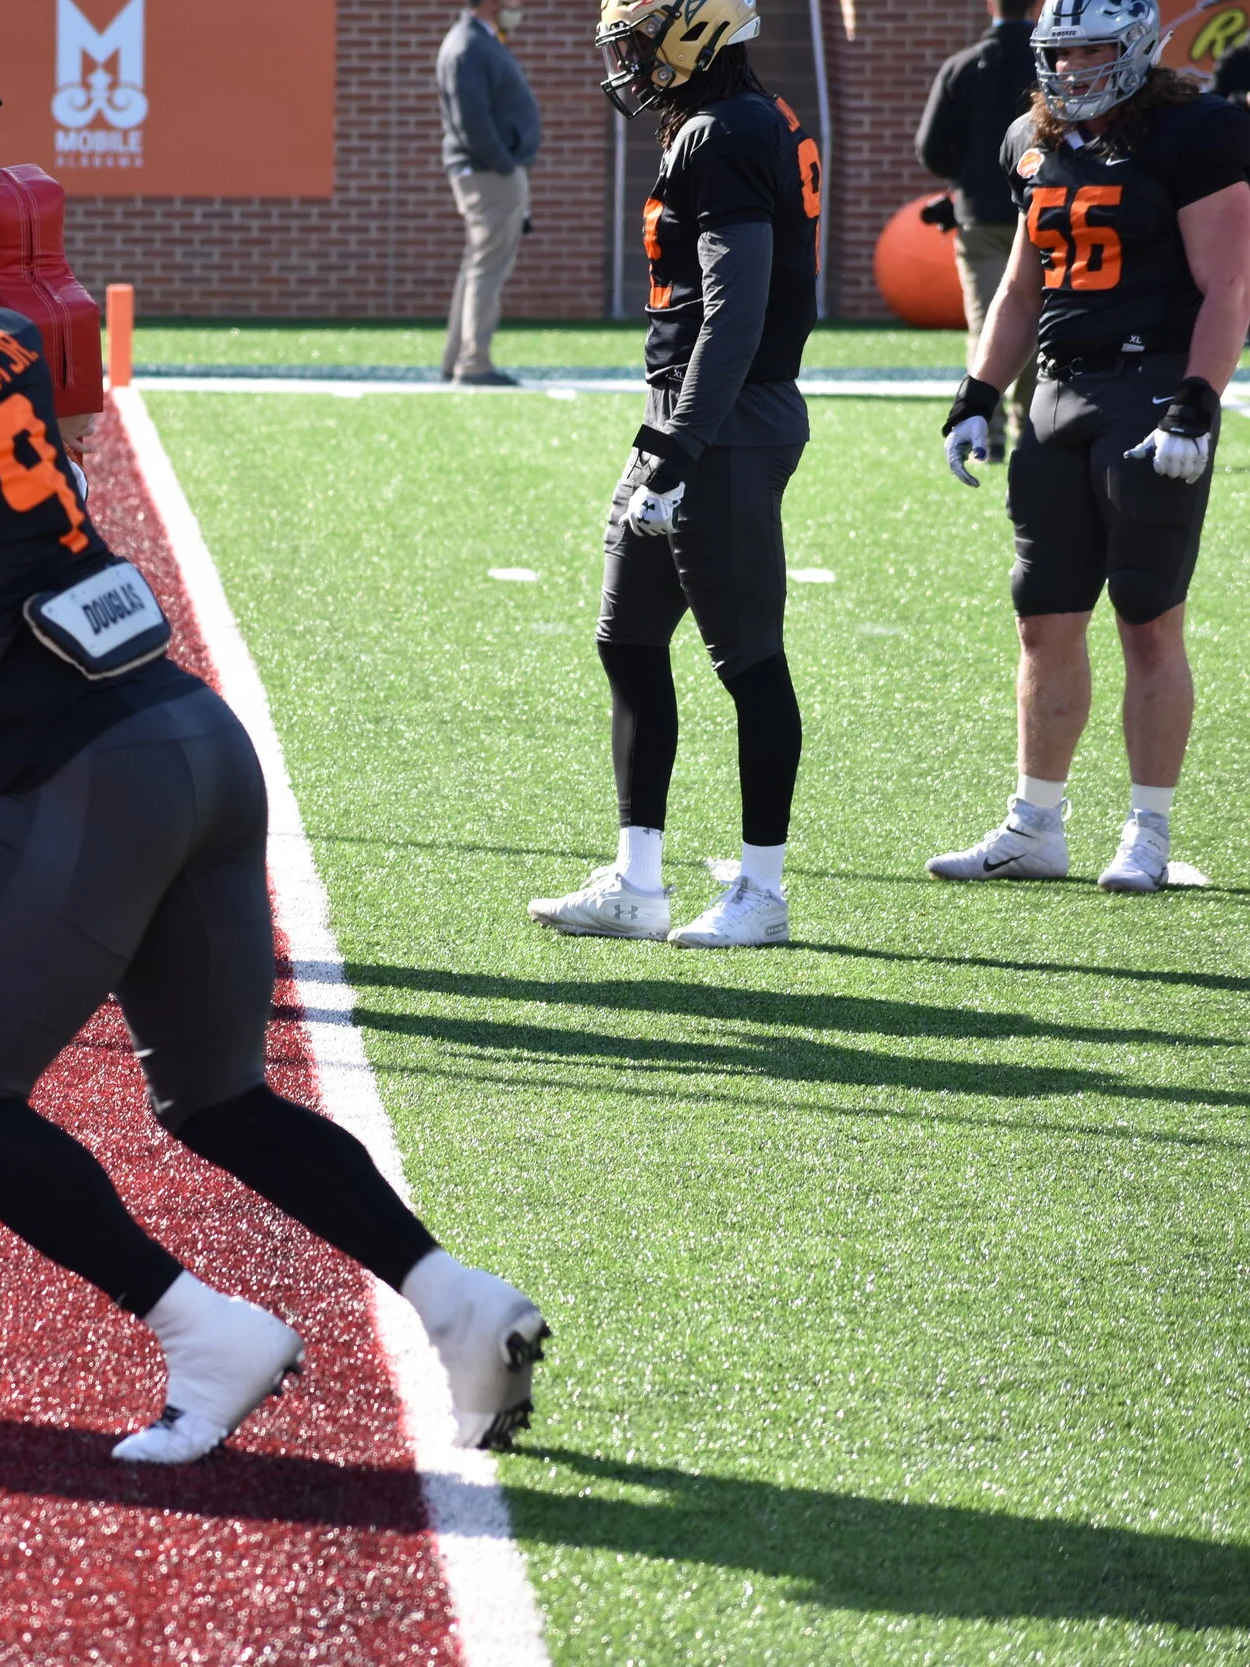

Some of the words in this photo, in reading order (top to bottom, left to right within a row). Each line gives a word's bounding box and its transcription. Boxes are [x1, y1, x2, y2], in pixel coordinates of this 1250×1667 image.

[55, 130, 142, 153] MOBILE
[1027, 185, 1123, 290] 56
[1130, 335, 1142, 344] XL
[81, 582, 145, 635] DOUGLAS
